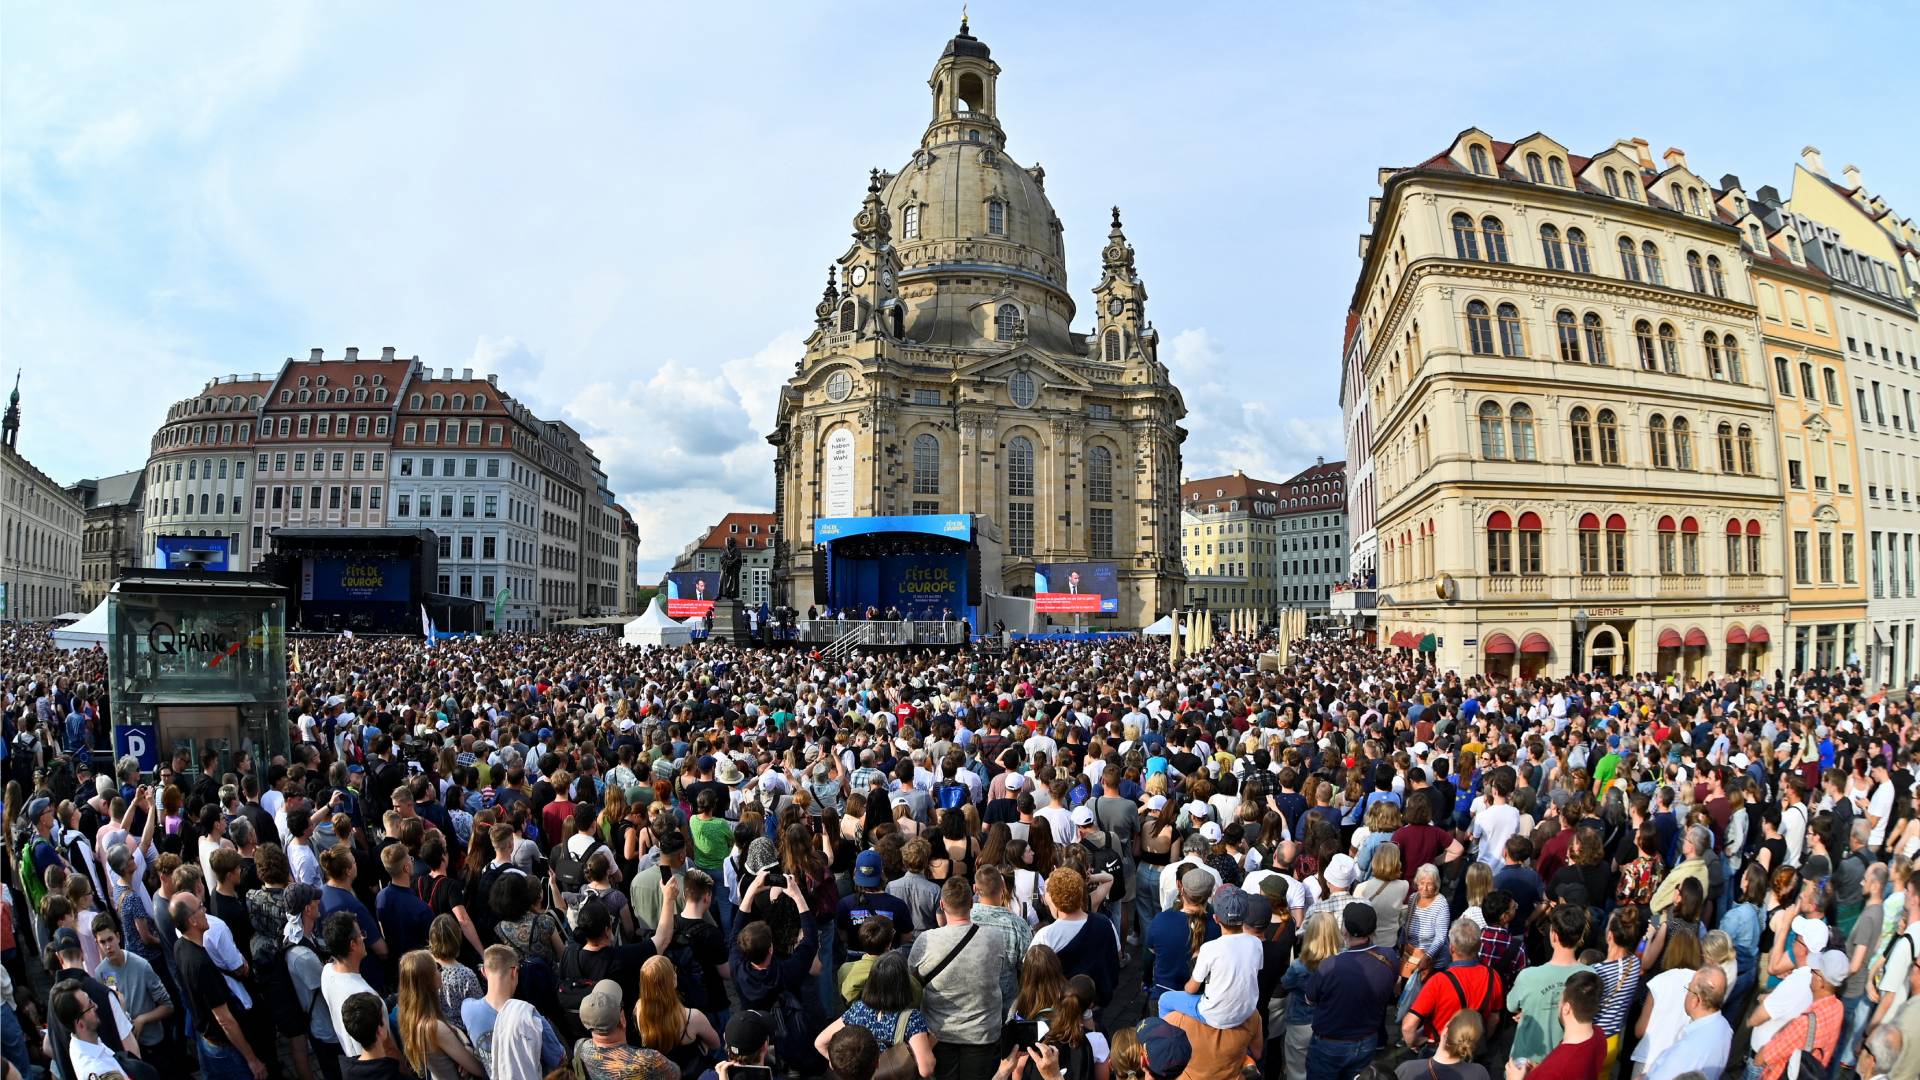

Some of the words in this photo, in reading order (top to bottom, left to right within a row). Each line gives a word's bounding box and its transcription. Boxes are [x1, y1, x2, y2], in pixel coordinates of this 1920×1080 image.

[367, 566, 379, 576] DE
[934, 568, 949, 580] DE
[1588, 608, 1625, 616] WEMPE
[128, 736, 146, 760] P
